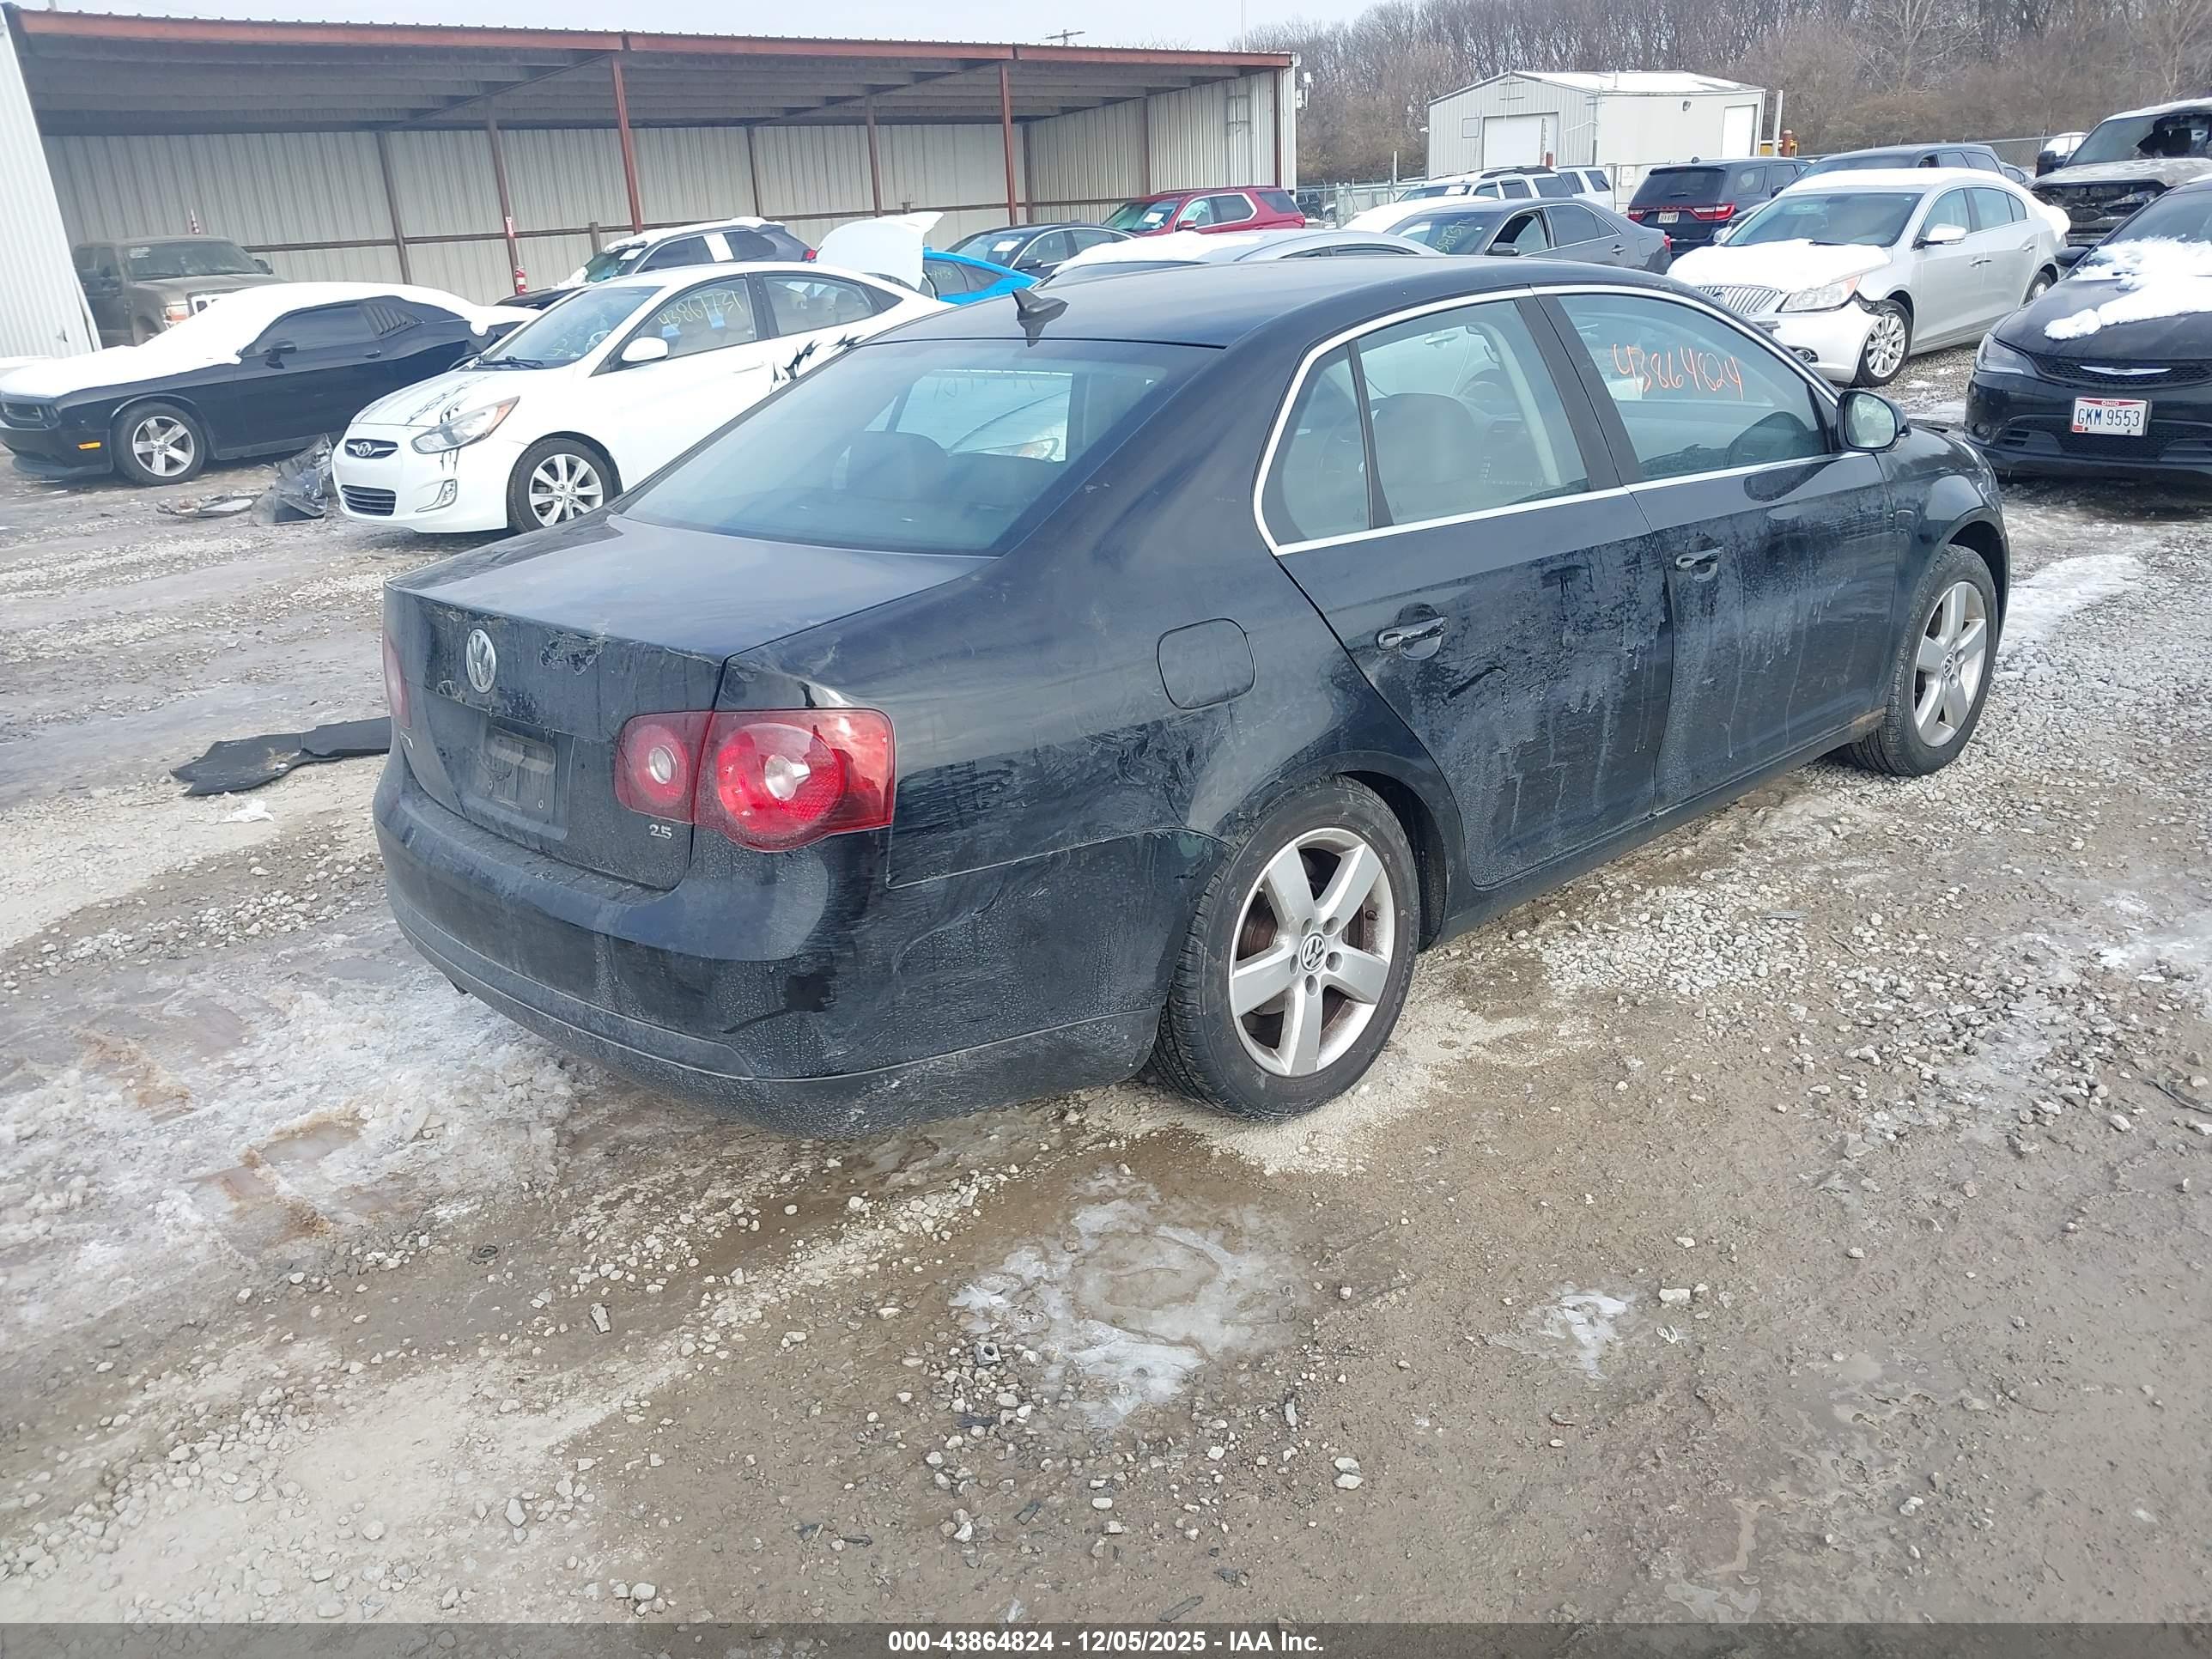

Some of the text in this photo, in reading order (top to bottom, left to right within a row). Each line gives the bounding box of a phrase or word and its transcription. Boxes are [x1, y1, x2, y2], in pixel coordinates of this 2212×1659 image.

[1613, 343, 1744, 401] 43864824
[2077, 408, 2141, 427] GKM 9553
